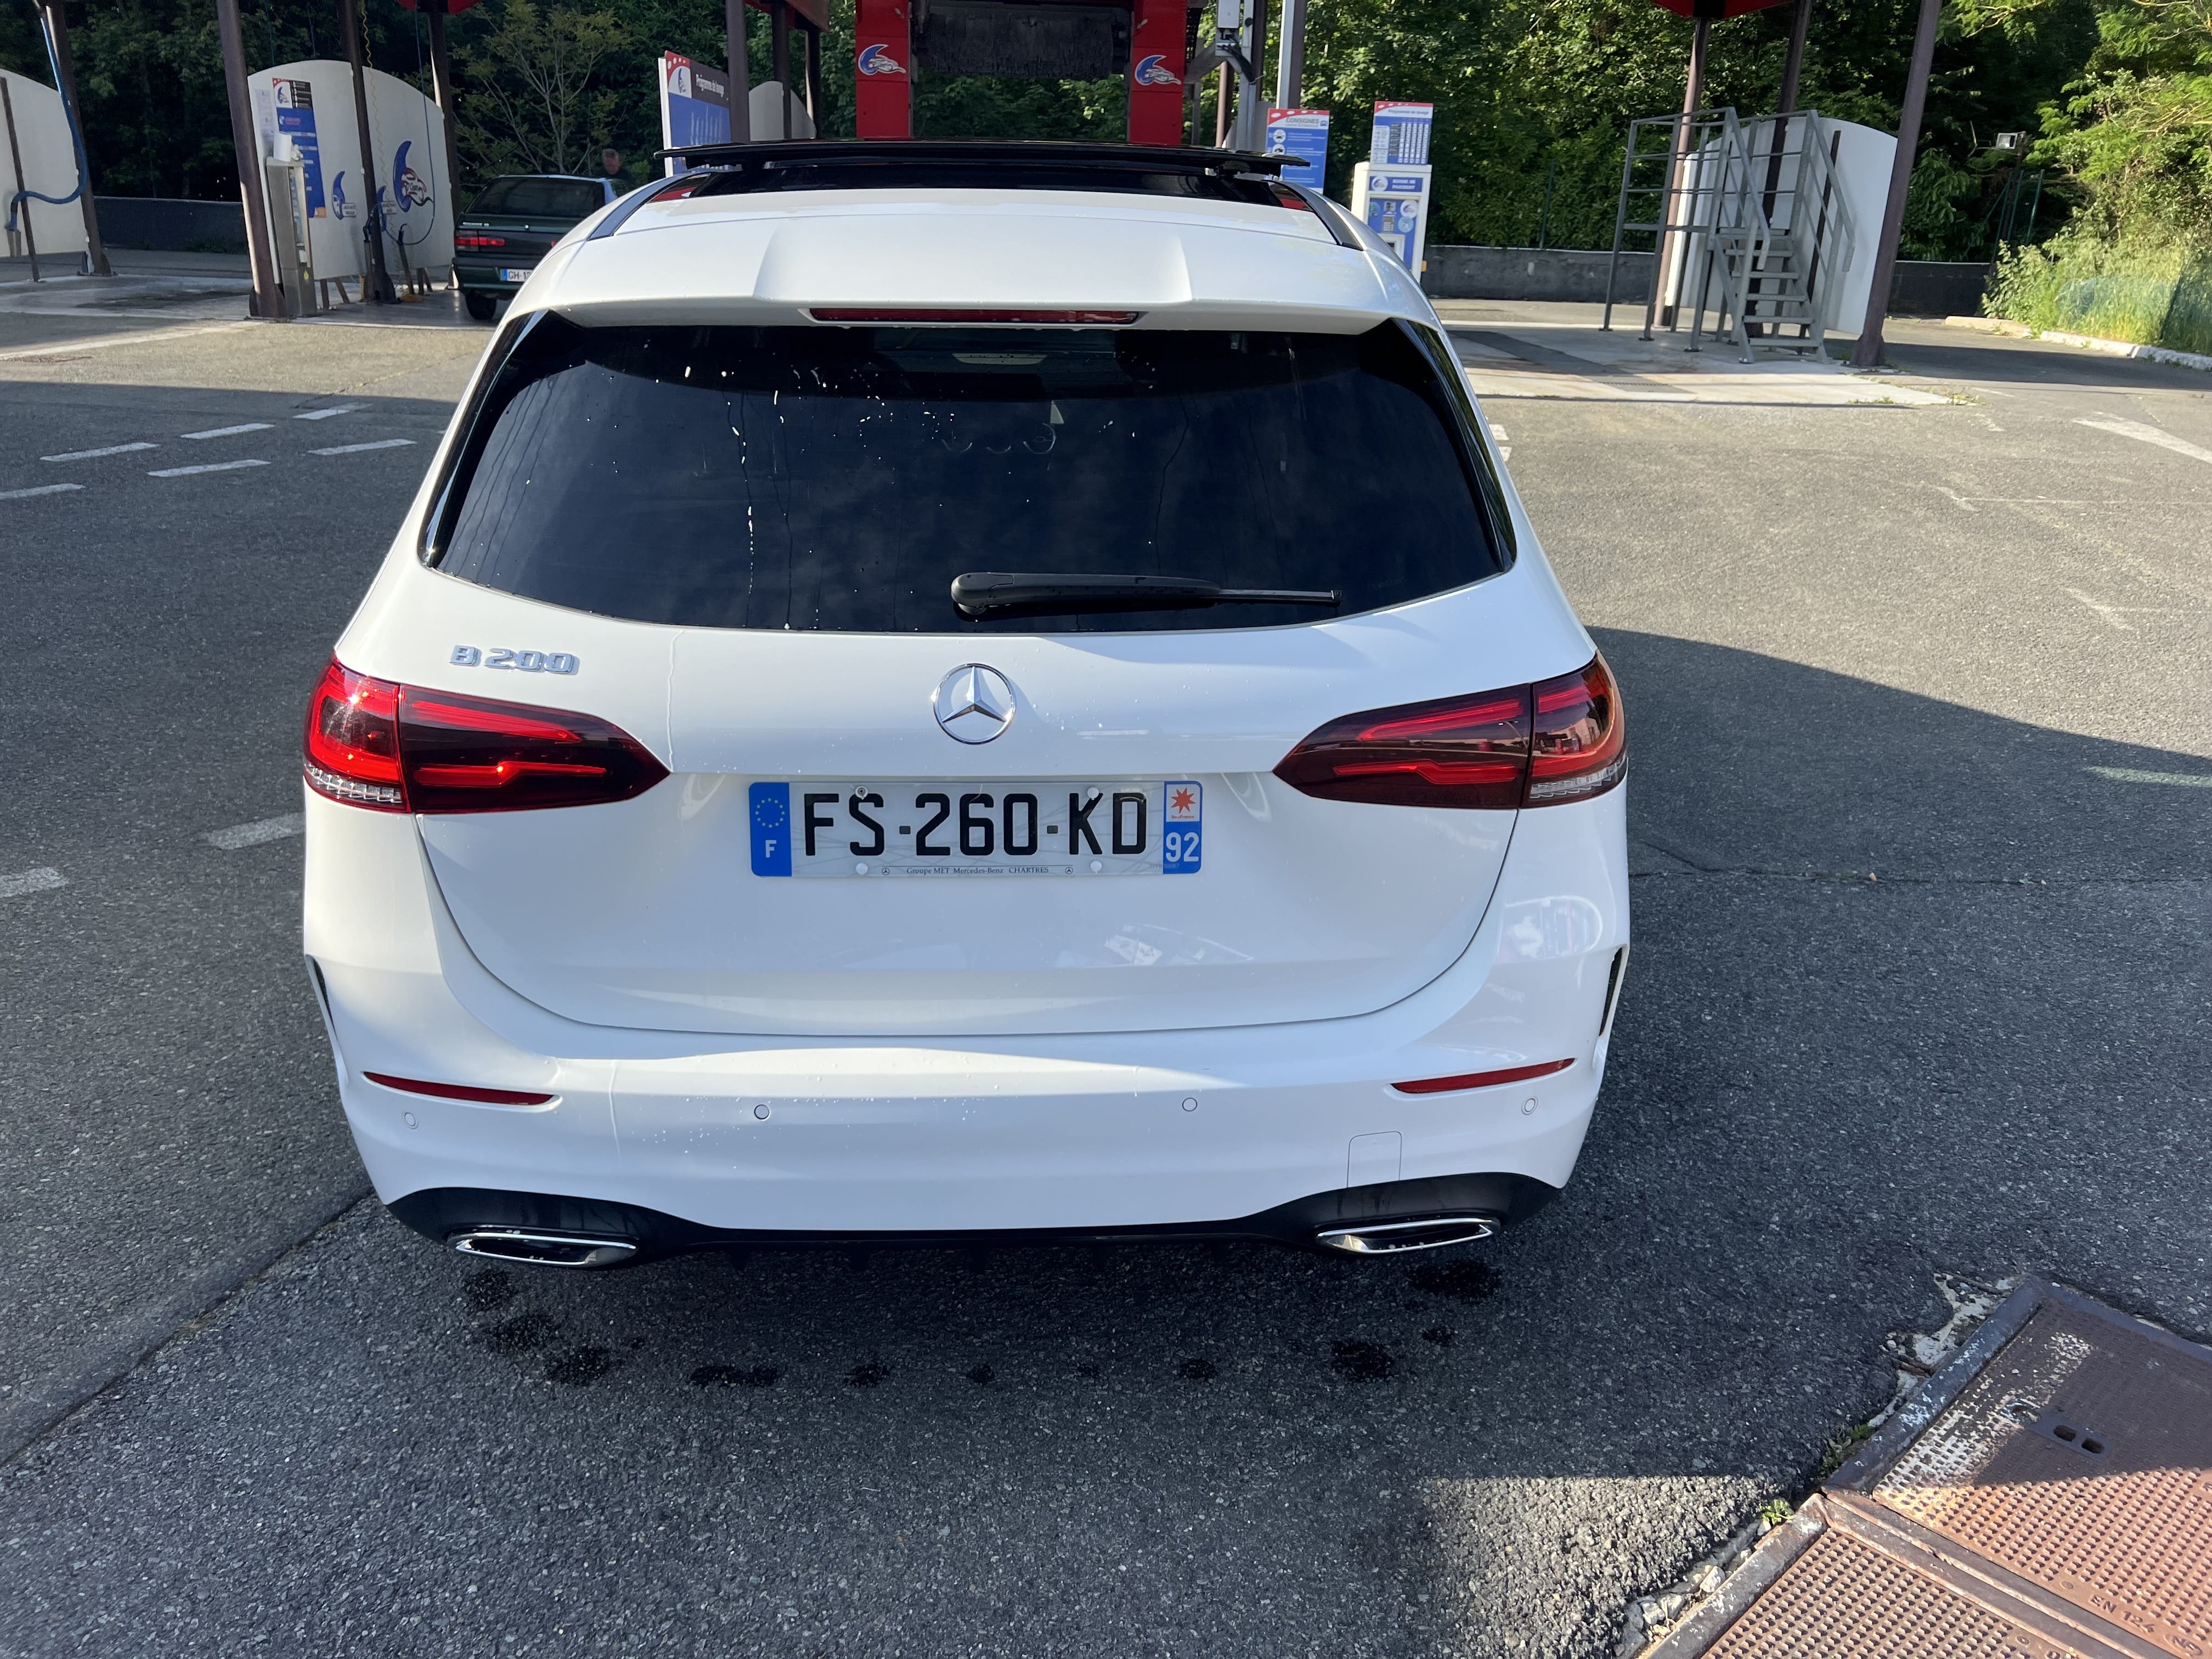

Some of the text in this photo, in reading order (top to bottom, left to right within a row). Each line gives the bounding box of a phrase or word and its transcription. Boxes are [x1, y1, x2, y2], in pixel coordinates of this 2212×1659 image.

[449, 645, 575, 675] B 200
[804, 793, 1147, 856] FS-260-KD
[765, 839, 777, 858] F
[1166, 832, 1199, 862] 92
[906, 867, 932, 876] Groupe
[1009, 866, 1049, 874] CHARTRES
[2090, 1594, 2155, 1633] EN 124
